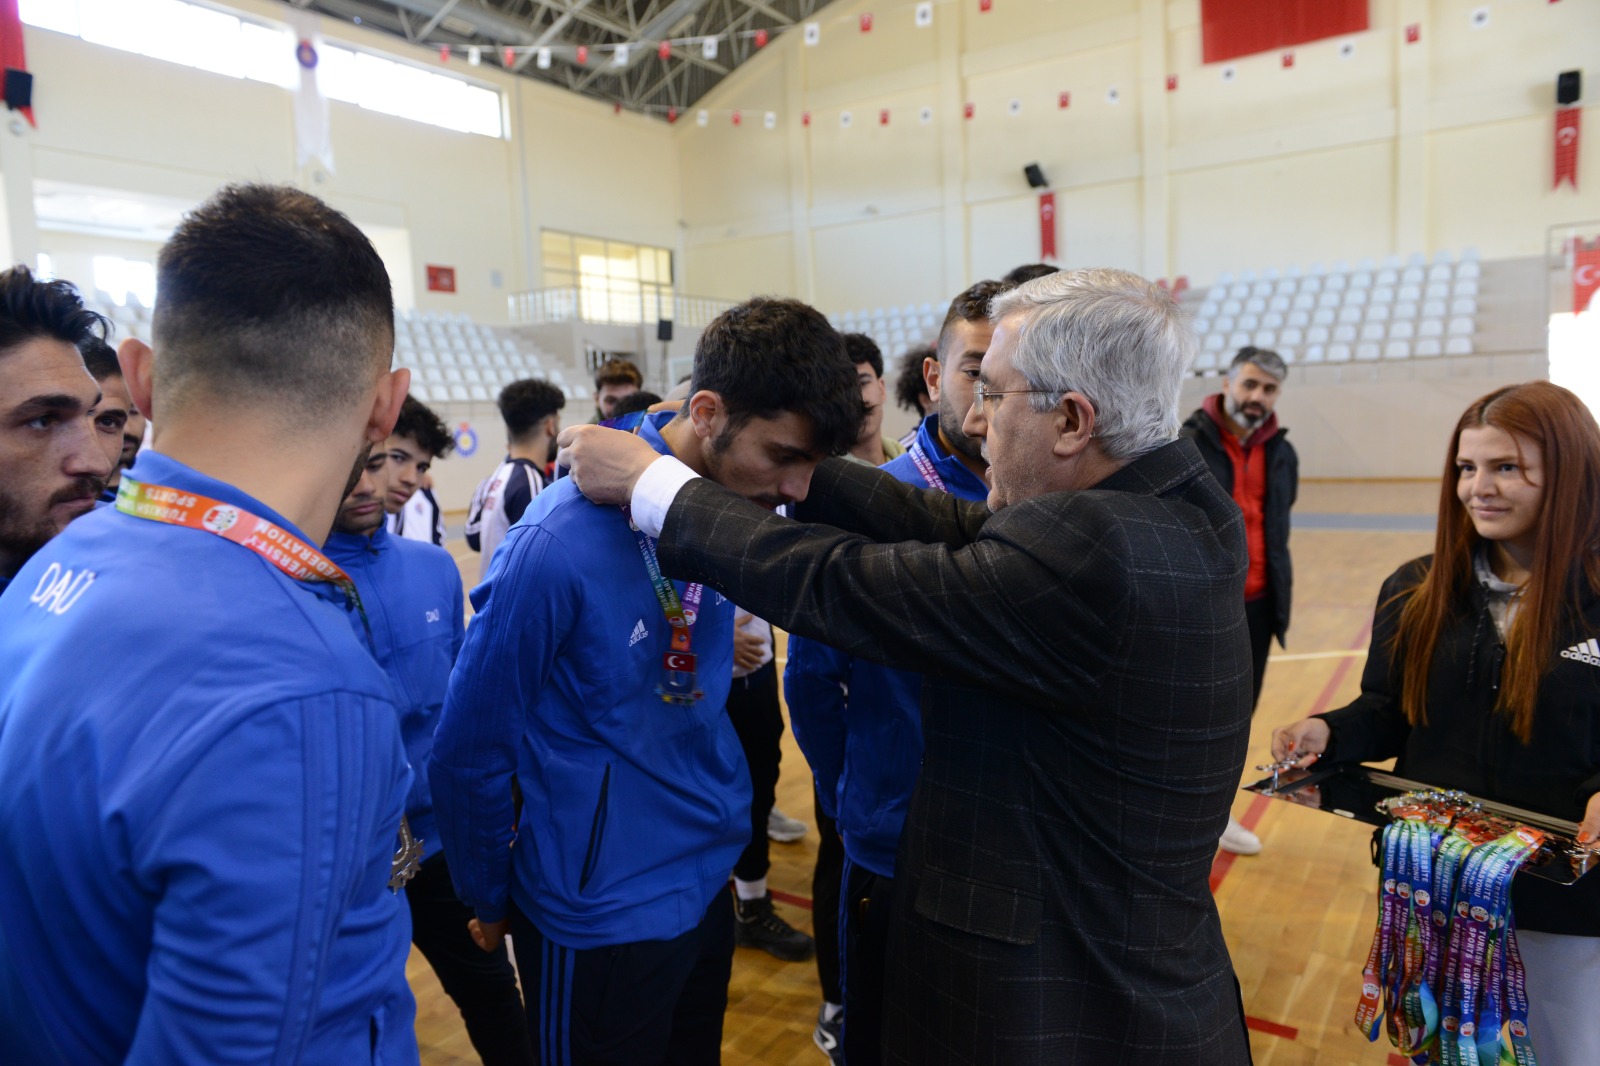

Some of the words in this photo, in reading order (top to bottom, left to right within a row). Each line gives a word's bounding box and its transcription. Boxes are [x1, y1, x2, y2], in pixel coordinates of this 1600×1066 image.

[30, 562, 96, 615] DAÜ
[1560, 650, 1600, 667] adida
[1465, 926, 1477, 959] SPORTS
